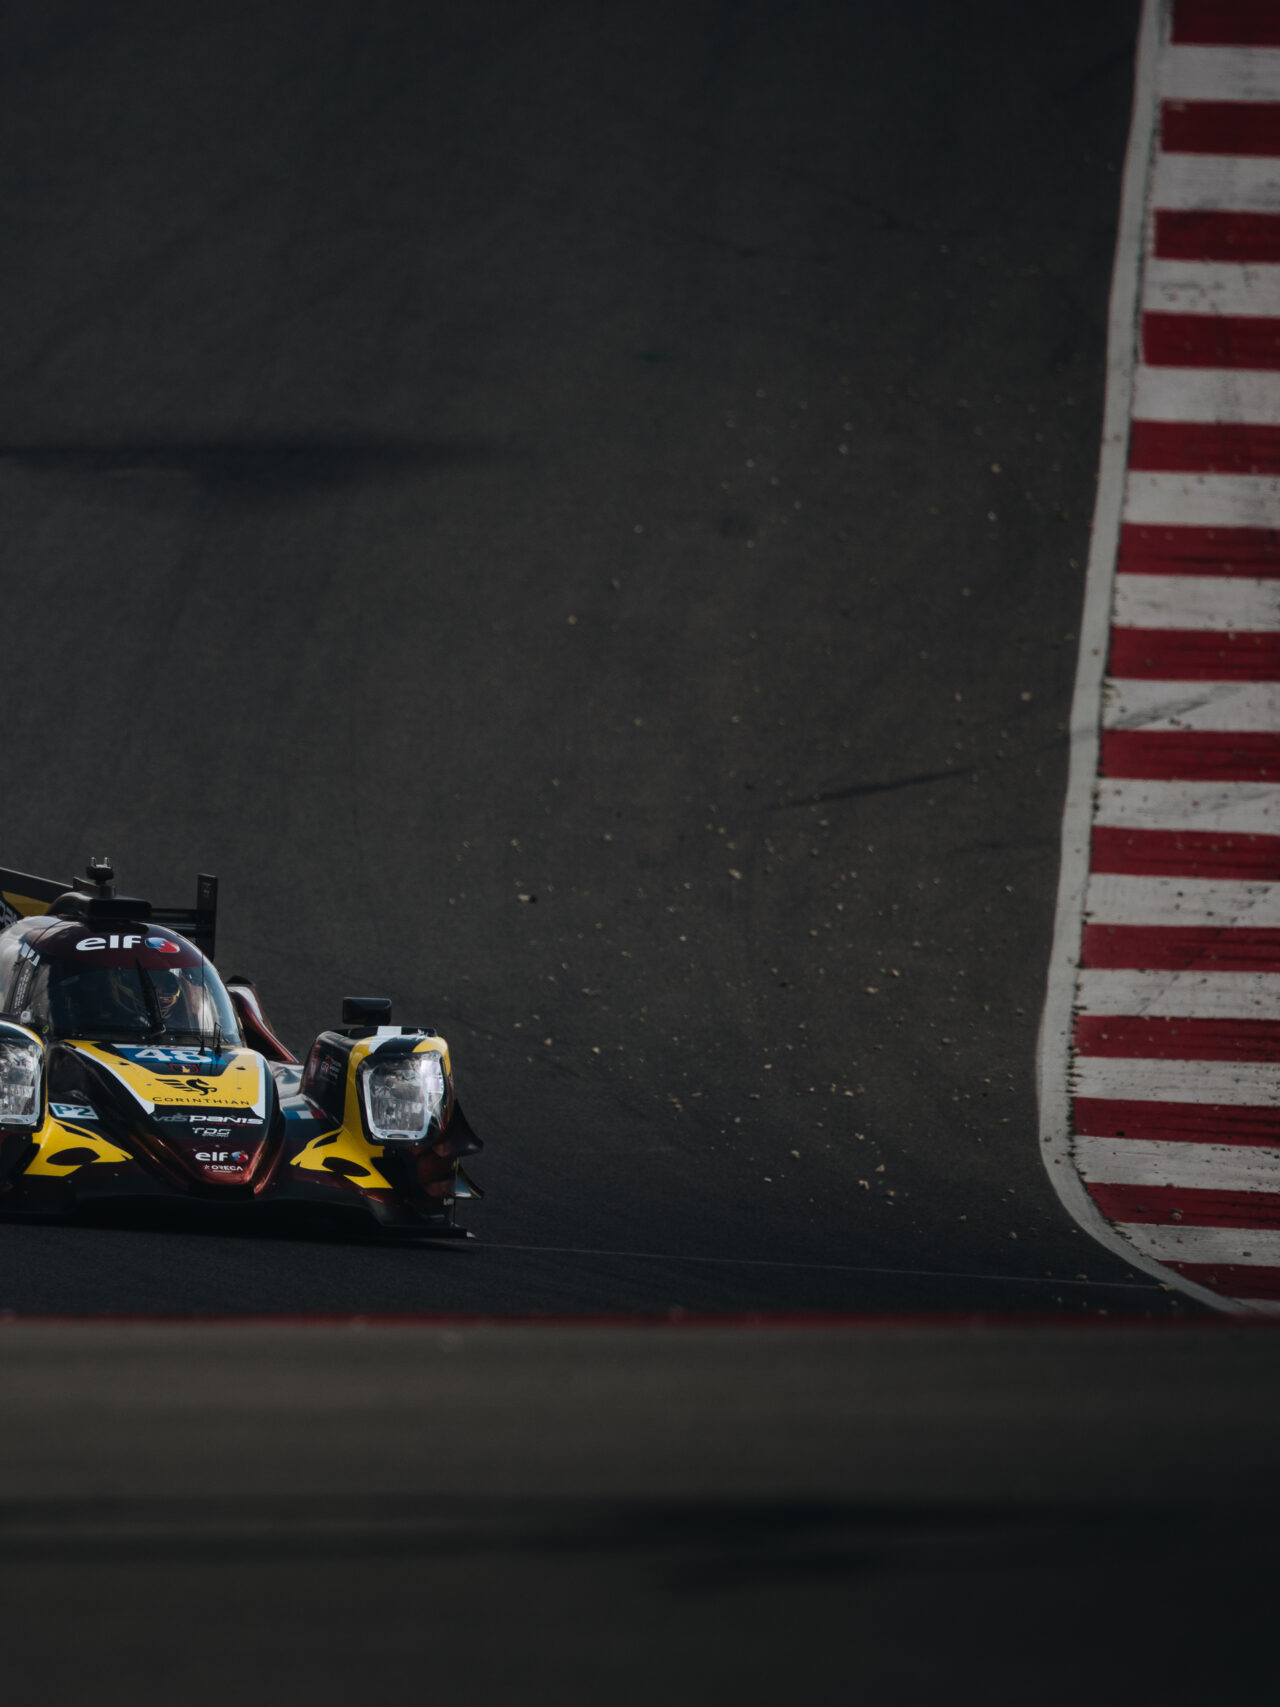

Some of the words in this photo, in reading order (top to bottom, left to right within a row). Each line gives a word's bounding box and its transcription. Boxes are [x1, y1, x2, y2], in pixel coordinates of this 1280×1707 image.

[75, 934, 142, 951] elf
[134, 1048, 213, 1064] 48
[152, 1096, 250, 1106] CORINTHIAN
[53, 1104, 95, 1117] P2
[194, 1151, 229, 1162] elf
